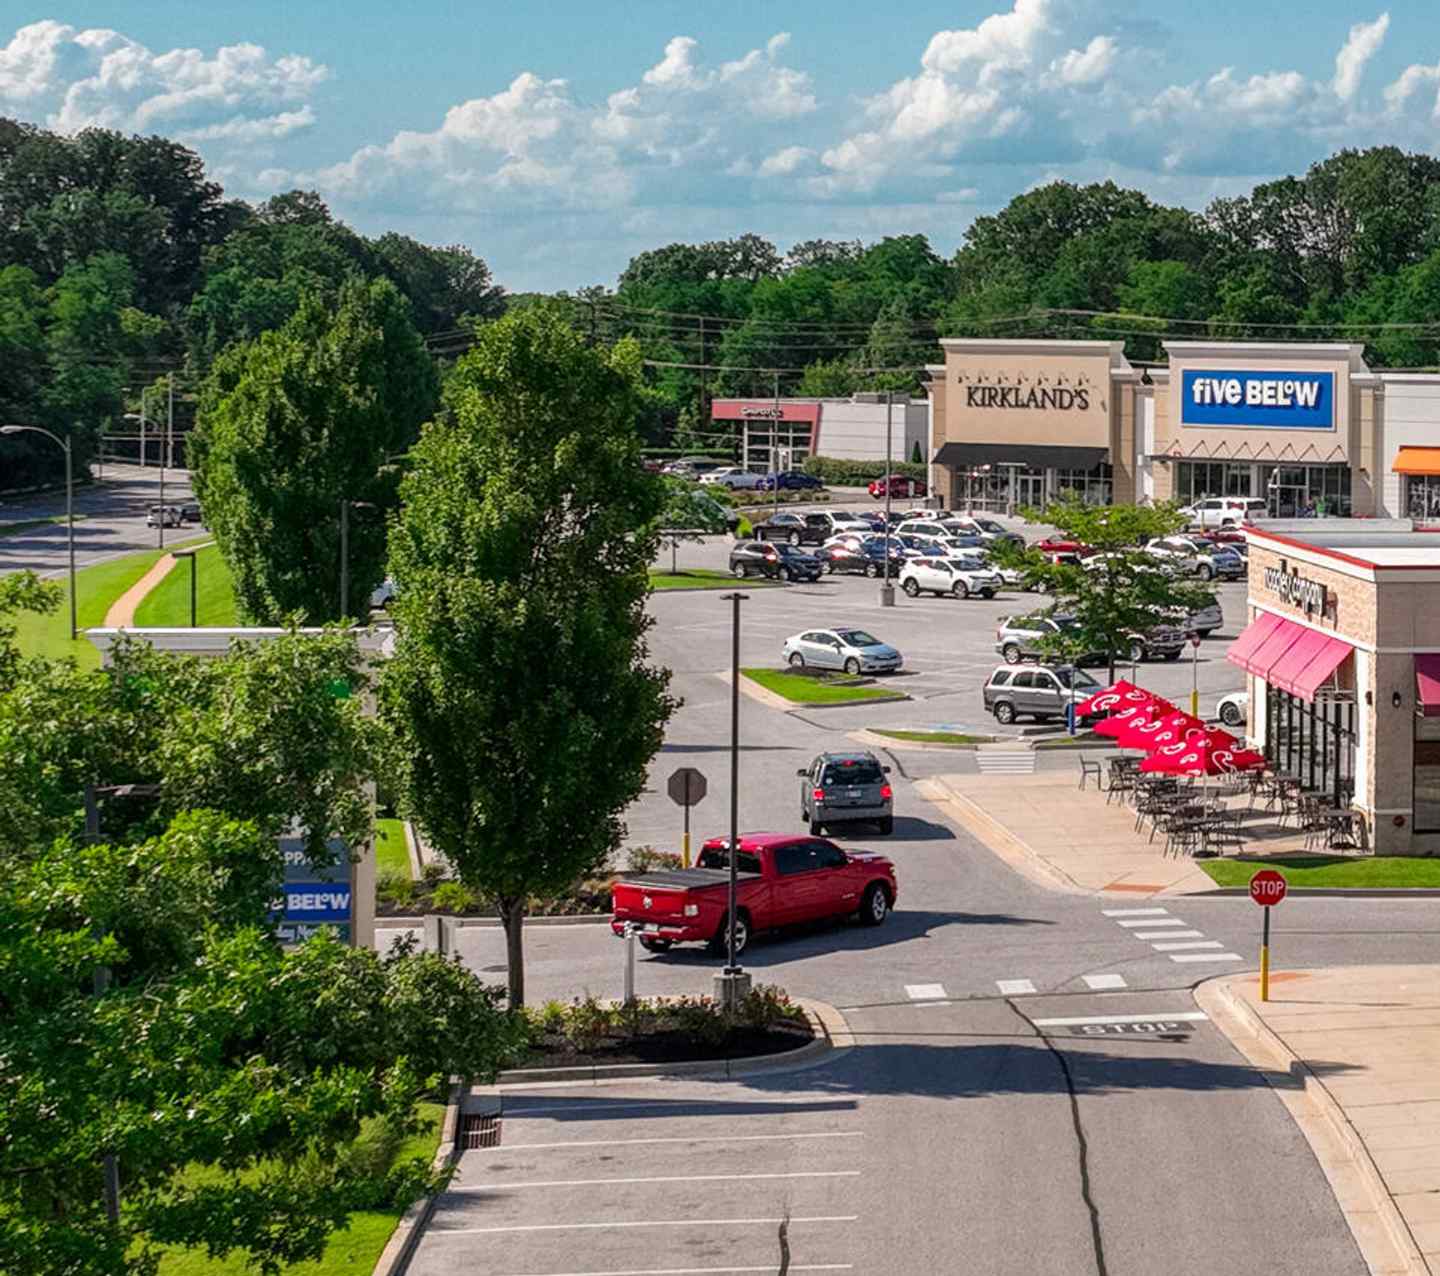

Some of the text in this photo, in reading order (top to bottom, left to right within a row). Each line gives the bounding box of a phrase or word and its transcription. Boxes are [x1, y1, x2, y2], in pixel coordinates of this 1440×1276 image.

[966, 386, 1089, 410] KIRKLAND'S
[1252, 880, 1284, 896] STOP
[1081, 1022, 1178, 1035] STOP
